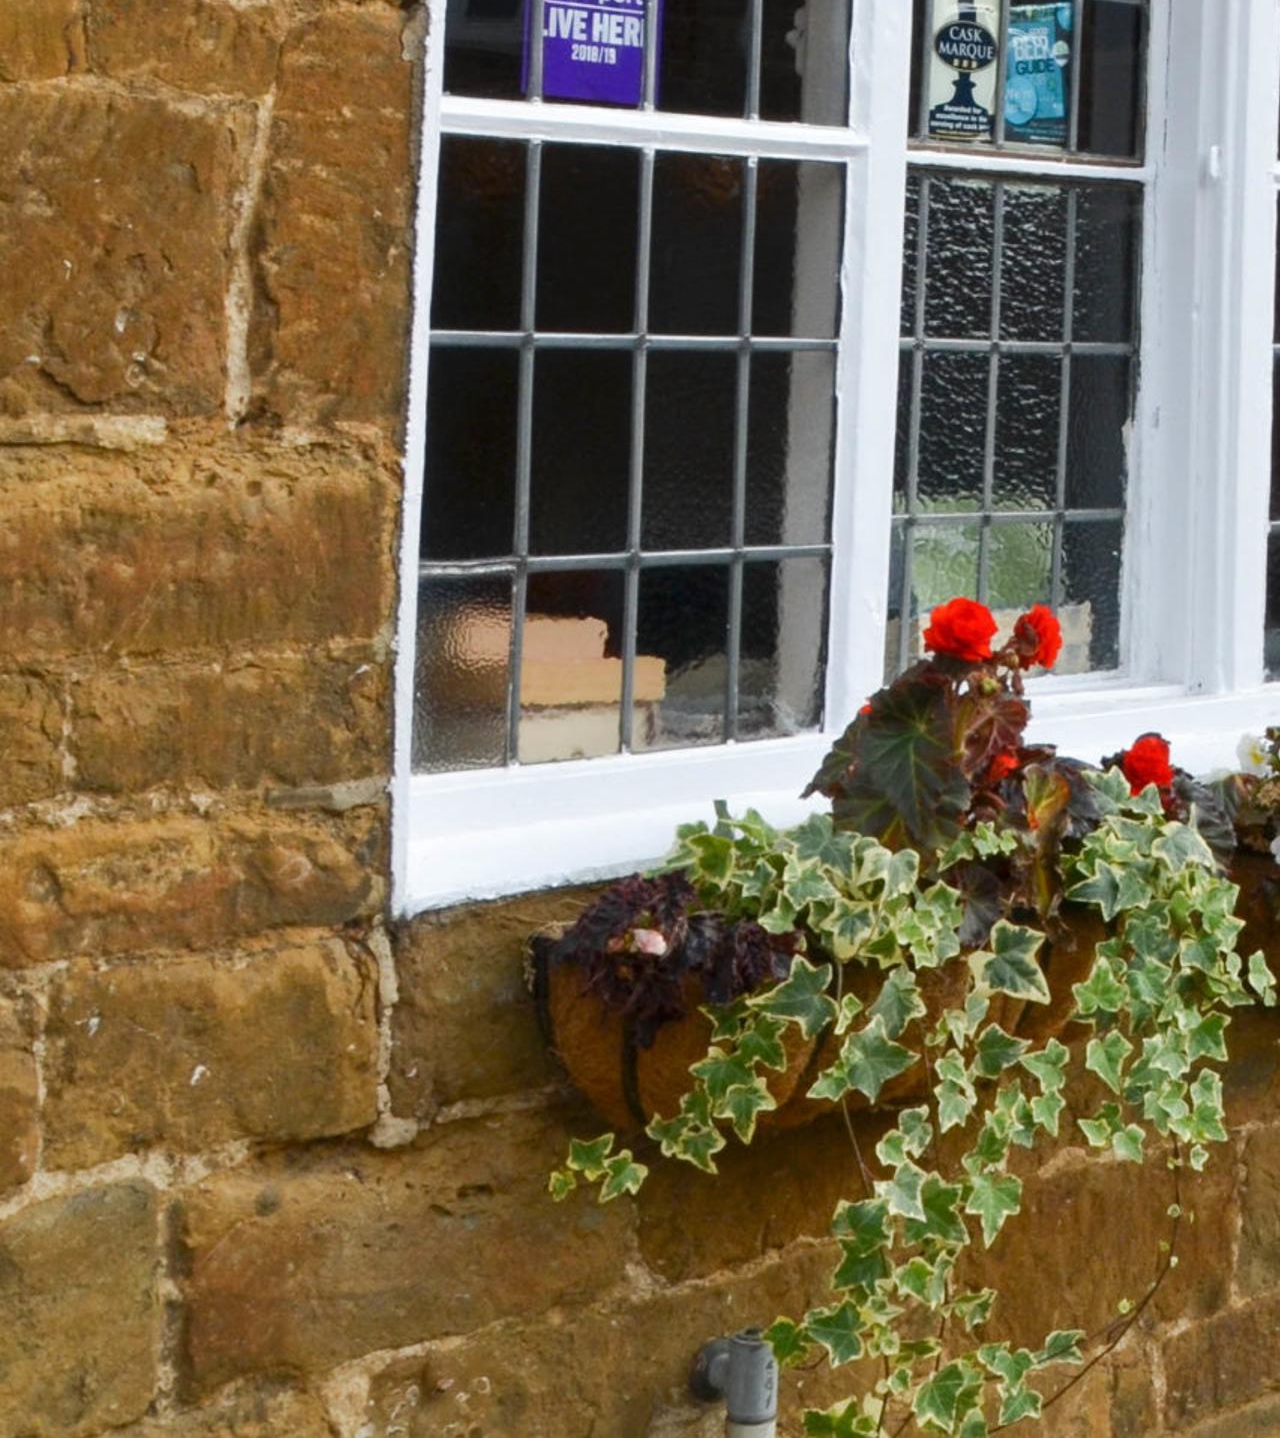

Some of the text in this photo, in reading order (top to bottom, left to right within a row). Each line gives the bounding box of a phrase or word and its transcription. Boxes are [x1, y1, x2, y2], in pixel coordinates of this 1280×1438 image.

[948, 25, 983, 44] CASK
[938, 41, 995, 60] MARQUE
[1014, 57, 1056, 76] GUIDE
